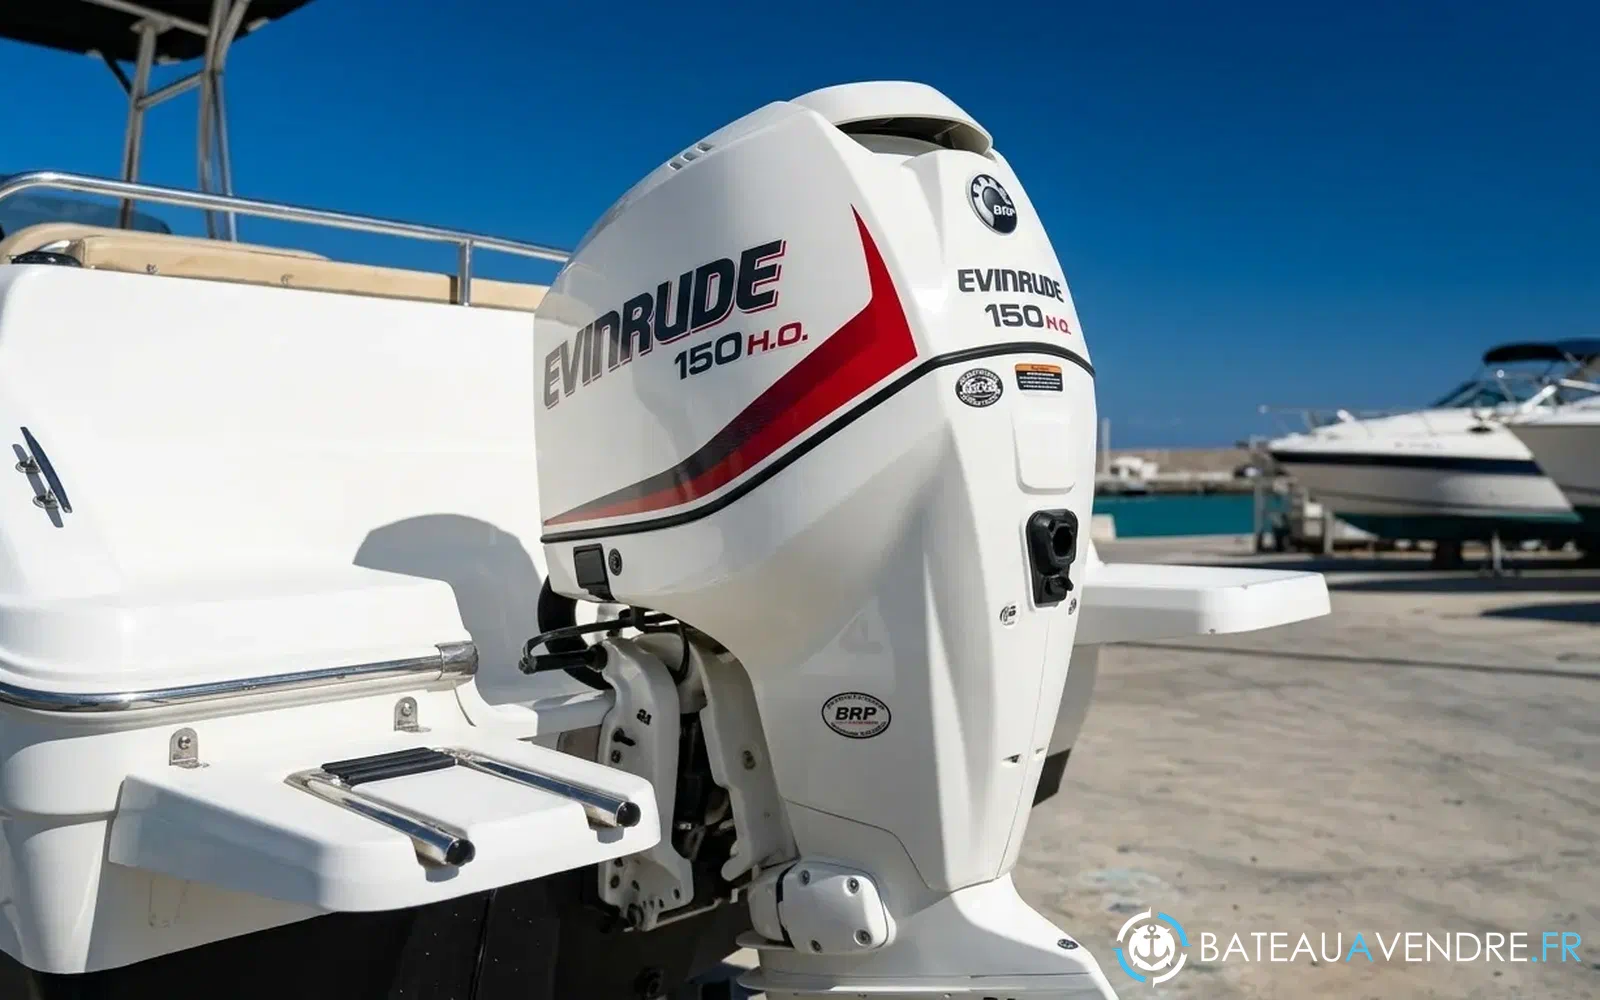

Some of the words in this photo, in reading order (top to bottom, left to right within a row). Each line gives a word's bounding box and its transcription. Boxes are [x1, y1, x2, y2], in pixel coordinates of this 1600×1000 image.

[957, 268, 1064, 303] EVINRUDE
[544, 239, 787, 409] EVINRUDE
[984, 303, 1044, 327] 150
[674, 331, 742, 380] 150
[747, 321, 809, 356] H.O.
[835, 706, 877, 720] BRP
